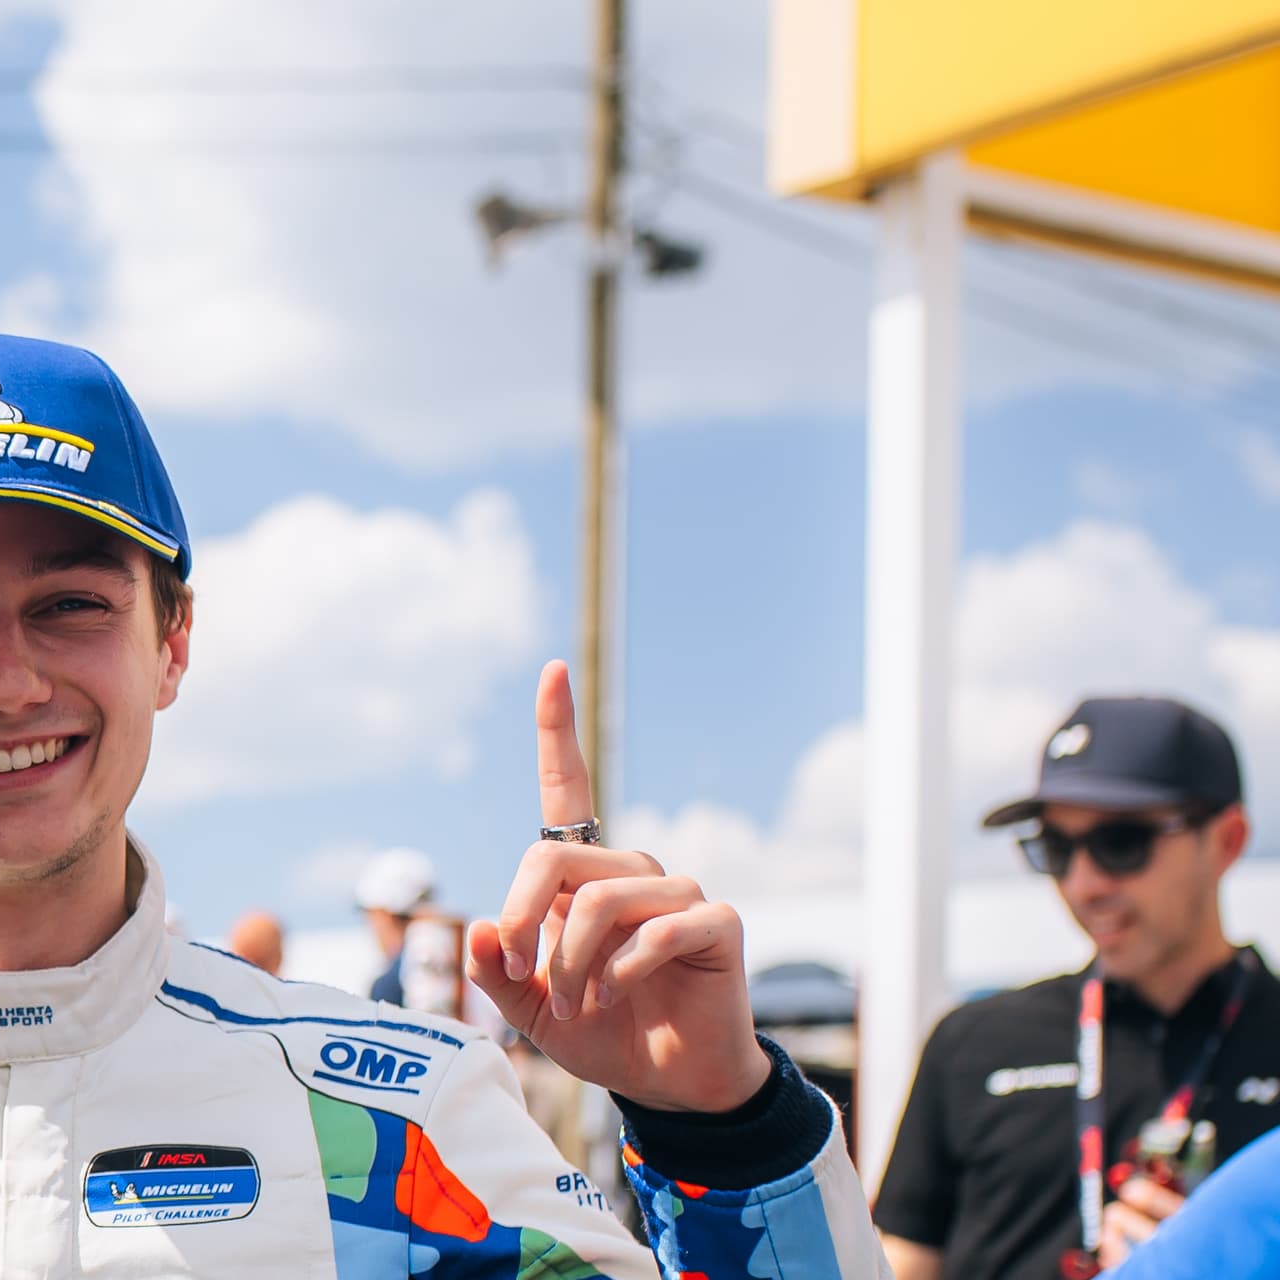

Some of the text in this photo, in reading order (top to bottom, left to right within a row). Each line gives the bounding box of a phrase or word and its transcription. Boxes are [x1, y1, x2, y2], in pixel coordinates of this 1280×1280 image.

[320, 1041, 427, 1084] OMP
[157, 1153, 206, 1165] IMSA
[142, 1183, 234, 1197] MICHELIN
[113, 1208, 230, 1224] PILOT CHALLENGE
